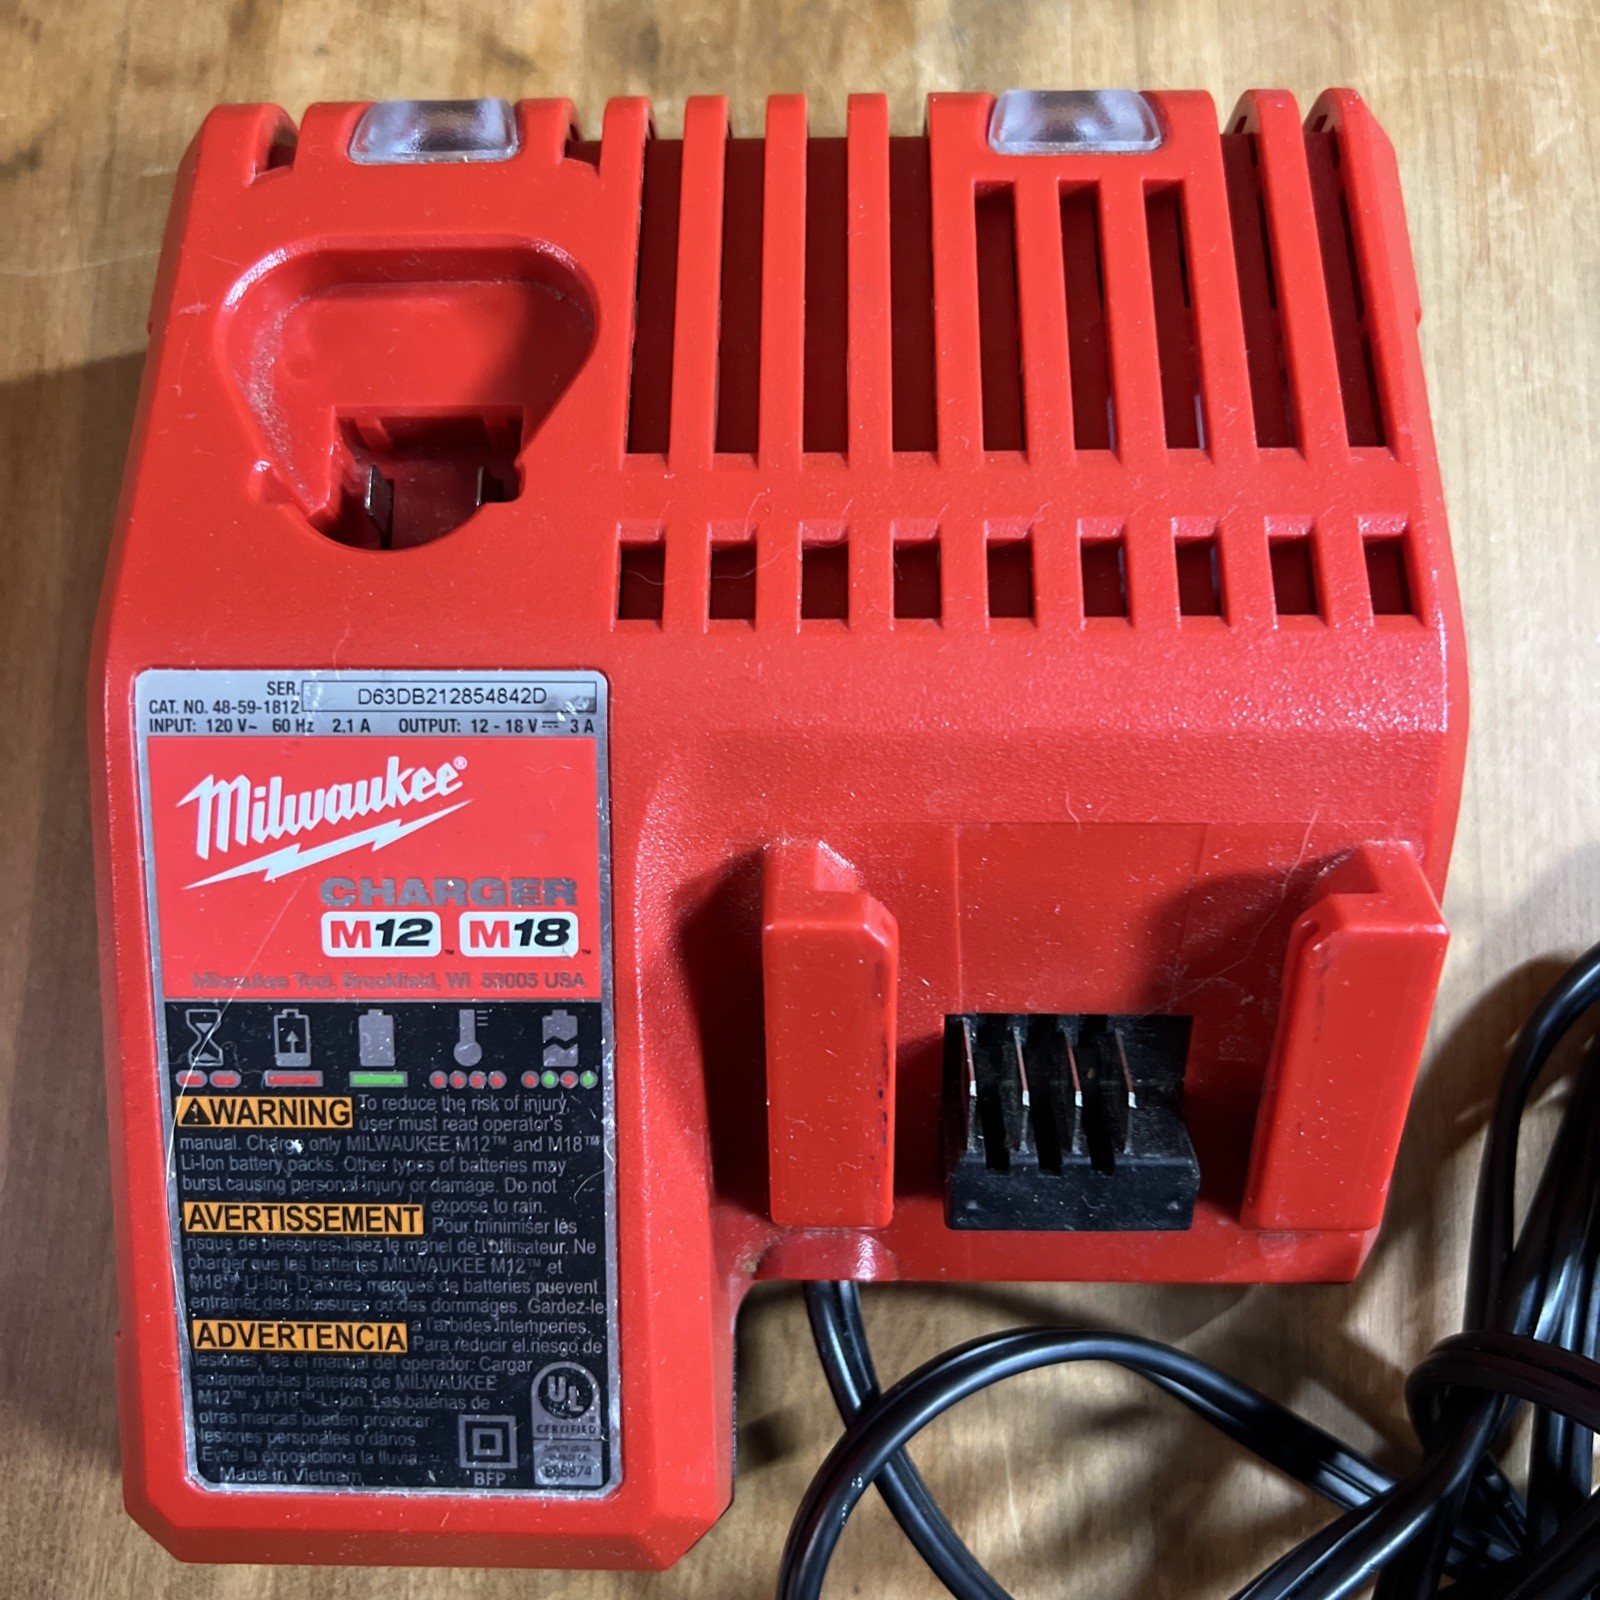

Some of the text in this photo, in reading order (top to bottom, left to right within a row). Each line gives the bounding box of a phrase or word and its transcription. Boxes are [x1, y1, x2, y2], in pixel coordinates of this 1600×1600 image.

[267, 681, 547, 705] SER. D63DB212854842D
[149, 699, 300, 715] CAT. NO. 48-59-1812
[149, 718, 196, 733] INPUT:
[206, 718, 233, 733] 120
[272, 718, 291, 733] 60
[295, 718, 314, 733] Hz
[332, 718, 354, 733] 2.1
[360, 718, 371, 733] A
[399, 718, 461, 734] OUTPUT:
[471, 719, 489, 733] 12
[506, 719, 524, 733] 18
[570, 719, 579, 734] 3
[584, 719, 595, 734] A
[319, 876, 579, 907] CHARGER
[330, 918, 433, 949] M12
[469, 918, 571, 949] M18
[445, 972, 471, 989] WI
[543, 972, 587, 989] USA
[208, 1098, 351, 1126] WARNING
[357, 1094, 378, 1111] To
[382, 1094, 437, 1111] reduce
[441, 1094, 467, 1111] the
[471, 1094, 500, 1111] risk
[504, 1094, 521, 1111] of
[358, 1116, 564, 1134] user must read operator's
[179, 1135, 242, 1152] manual.
[308, 1136, 342, 1155] only
[346, 1136, 450, 1152] MILWAUKEE
[513, 1137, 543, 1152] and
[229, 1155, 282, 1175] battery
[287, 1155, 338, 1175] packs.
[344, 1155, 389, 1172] Other
[392, 1158, 435, 1176] types
[439, 1157, 455, 1173] of
[459, 1157, 528, 1173] batteries
[532, 1161, 567, 1176] may
[182, 1175, 558, 1197] burst causing personal injury or damage. Do not
[187, 1204, 421, 1232] AVERTISSEMENT
[431, 1199, 548, 1218] expose to rain.
[431, 1218, 578, 1235] Pour minimiser les
[186, 1236, 234, 1253] risque
[238, 1236, 258, 1251] de
[345, 1237, 381, 1253] lisez
[385, 1237, 400, 1253] le
[457, 1237, 478, 1254] de
[573, 1238, 597, 1255] Ne
[187, 1256, 247, 1273] charger
[251, 1257, 281, 1273] que
[284, 1256, 307, 1271] les
[312, 1256, 379, 1273] batteries
[383, 1256, 486, 1274] MILWAUKEE
[547, 1258, 564, 1275] et
[297, 1275, 362, 1292] D'autres
[367, 1278, 435, 1296] marques
[439, 1277, 459, 1293] de
[463, 1278, 531, 1294] batteries
[535, 1278, 599, 1297] puevent
[263, 1295, 291, 1310] des
[295, 1296, 370, 1311] blessures
[398, 1297, 427, 1312] des
[431, 1297, 523, 1317] dommages.
[196, 1322, 406, 1351] ADVERTENCIA
[413, 1336, 603, 1357] Para reducir el riesgo de
[267, 1353, 290, 1368] lea
[313, 1355, 369, 1370] manual
[373, 1355, 397, 1370] del
[479, 1356, 533, 1376] Cargar
[196, 1372, 276, 1387] solamente
[280, 1374, 301, 1388] las
[371, 1374, 391, 1390] de
[395, 1374, 498, 1391] MILWAUKEE
[471, 1396, 491, 1411] de
[547, 1375, 584, 1413] UL
[198, 1410, 431, 1429] otras marcas pueden provocar
[199, 1429, 263, 1444] lesiones
[267, 1430, 351, 1447] personales
[243, 1447, 258, 1463] la
[360, 1449, 374, 1465] la
[219, 1466, 363, 1484] Made in Vietnam
[474, 1472, 507, 1486] BFP
